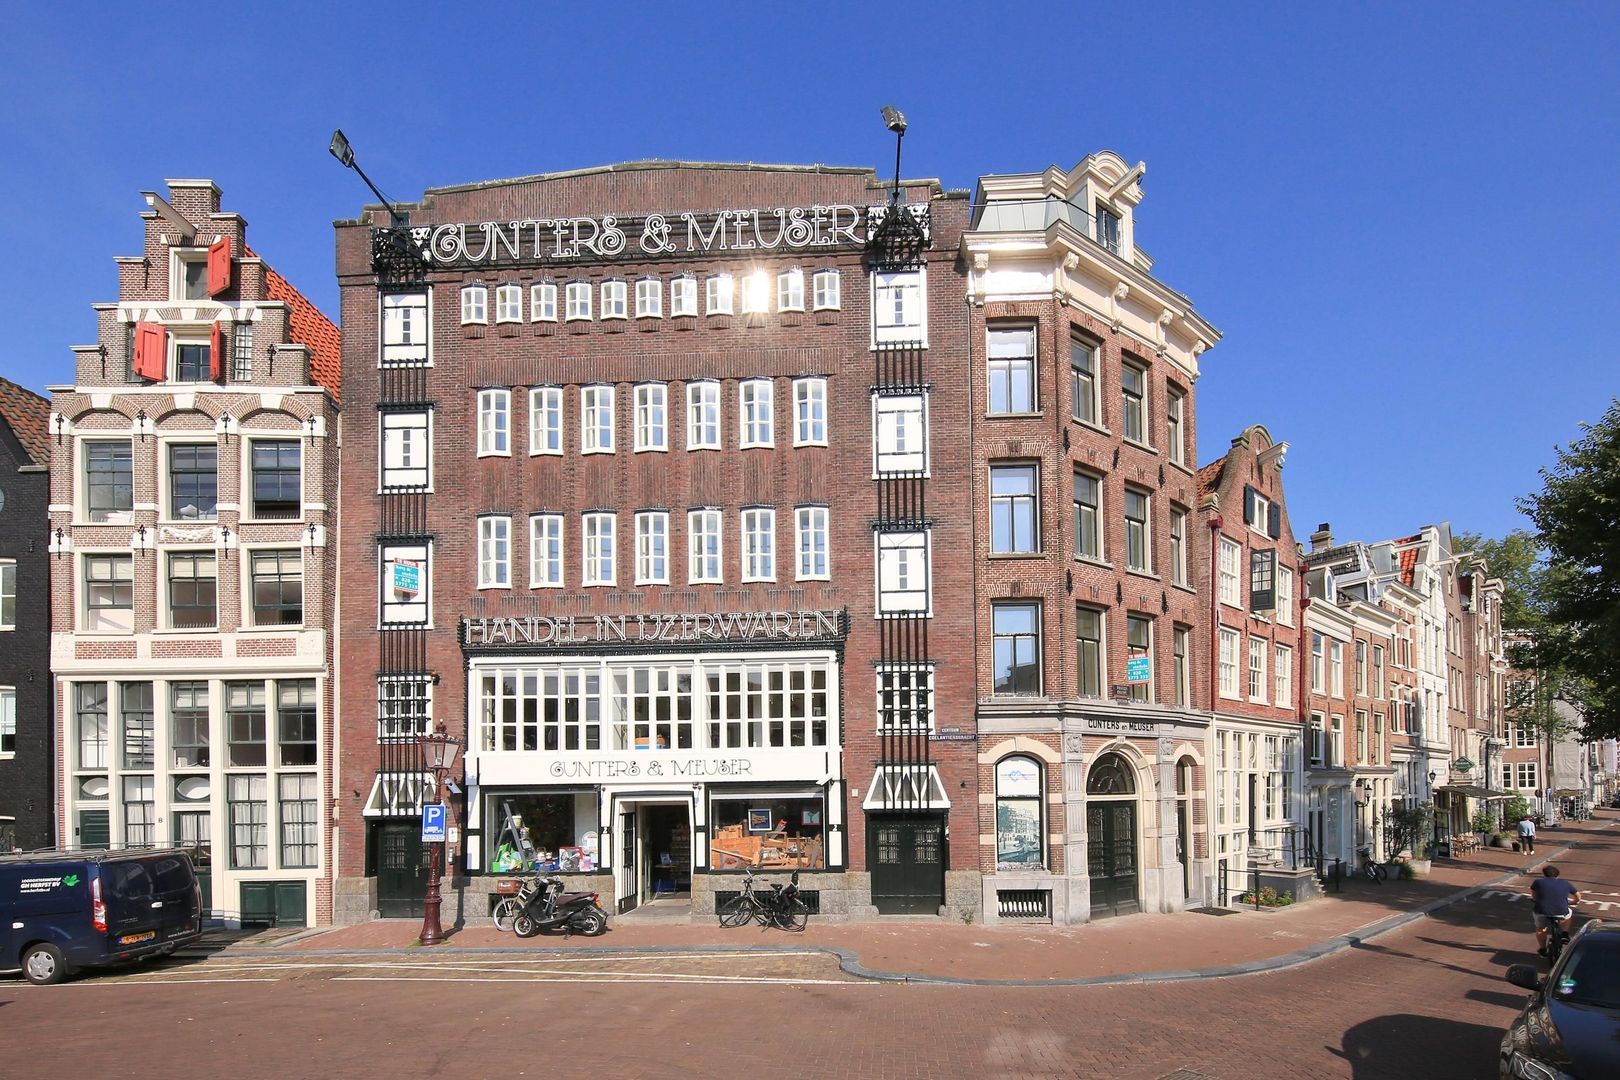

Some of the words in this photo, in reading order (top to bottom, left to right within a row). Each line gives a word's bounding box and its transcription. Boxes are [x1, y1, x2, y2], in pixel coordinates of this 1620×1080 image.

[430, 215, 627, 263] GUNTERS
[640, 213, 676, 254] &
[681, 204, 865, 251] MEUSER
[463, 616, 588, 644] HANDEL
[594, 615, 627, 641] IN
[636, 610, 841, 640] IJZERWAREN
[1088, 718, 1120, 730] GUNTERS
[1128, 722, 1154, 732] MEUSER
[550, 760, 640, 778] GUNTERS
[647, 760, 664, 776] &
[671, 758, 753, 776] MEUSER
[428, 808, 440, 823] P
